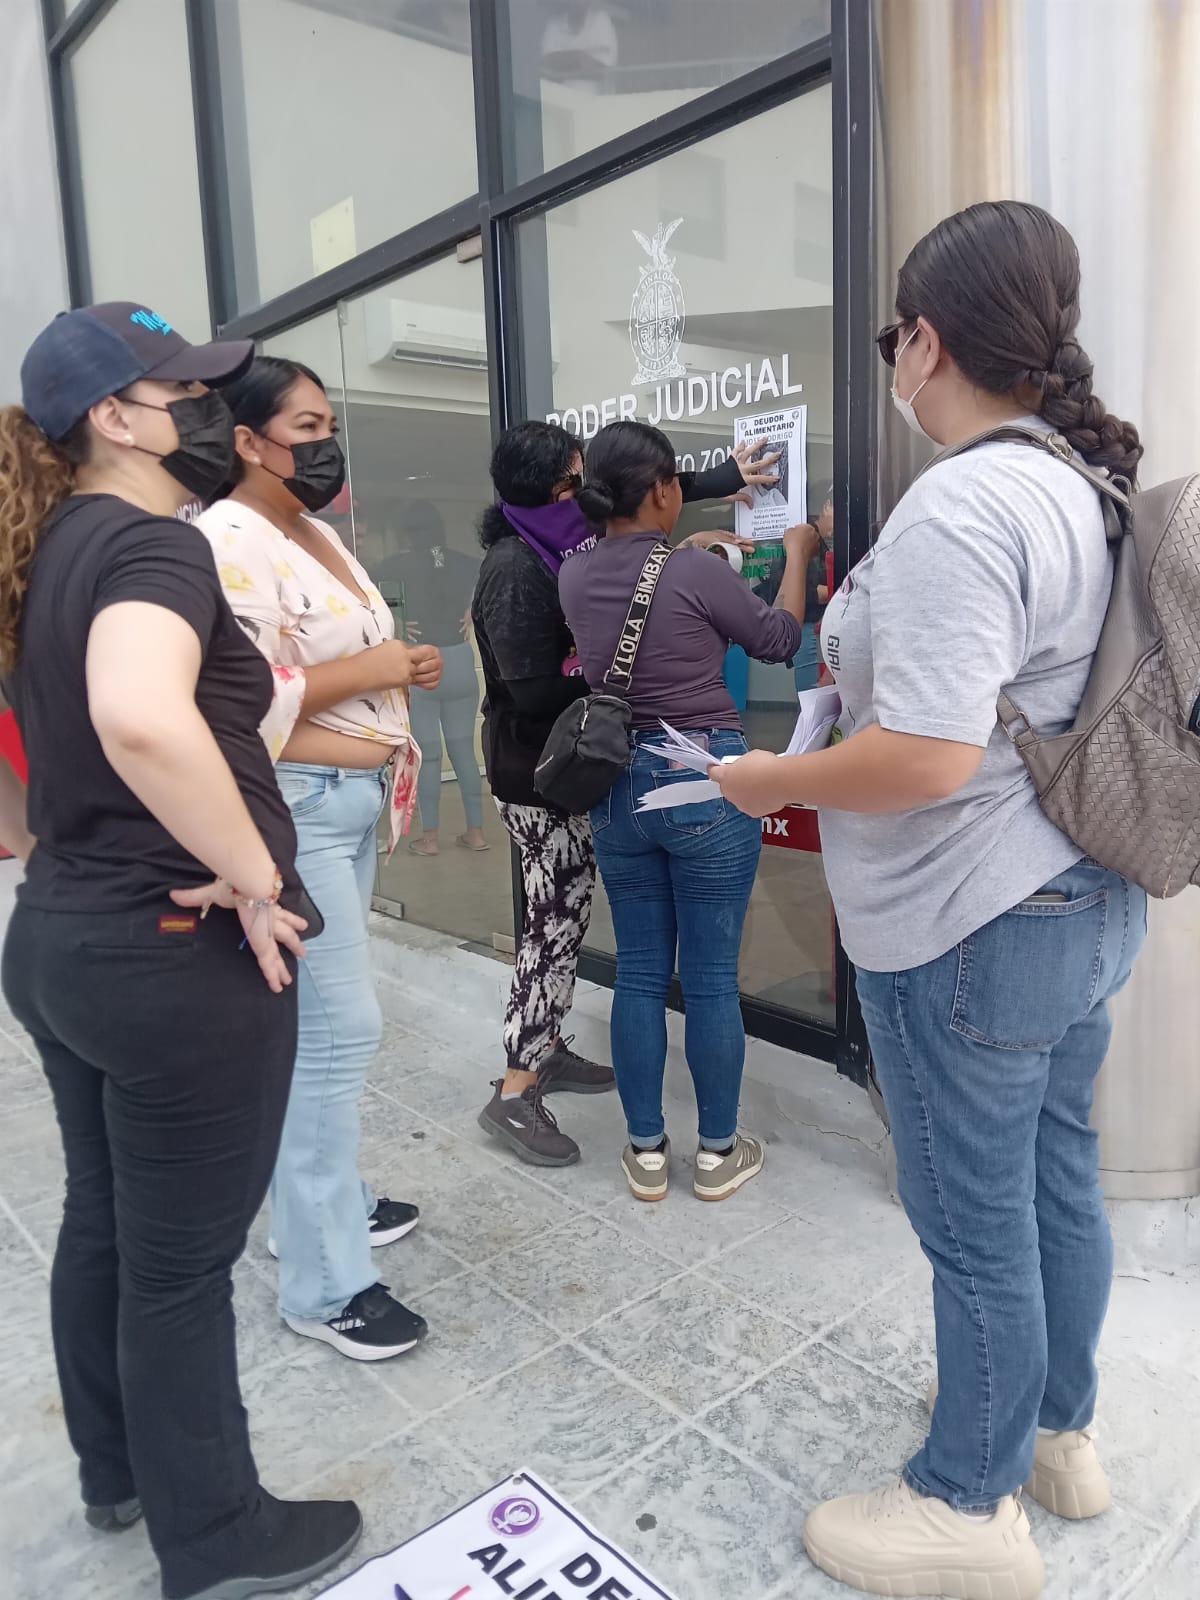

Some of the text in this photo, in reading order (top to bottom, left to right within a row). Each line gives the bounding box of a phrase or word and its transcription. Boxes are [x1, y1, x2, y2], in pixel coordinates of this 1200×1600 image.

[648, 353, 803, 425] JUDICIAL
[744, 421, 795, 437] ALIMENTARIO
[754, 414, 784, 426] DEUDOR
[767, 431, 793, 442] ODRIGO
[617, 618, 643, 664] LOLA
[466, 1543, 563, 1600] ALI
[559, 1552, 642, 1600] DE
